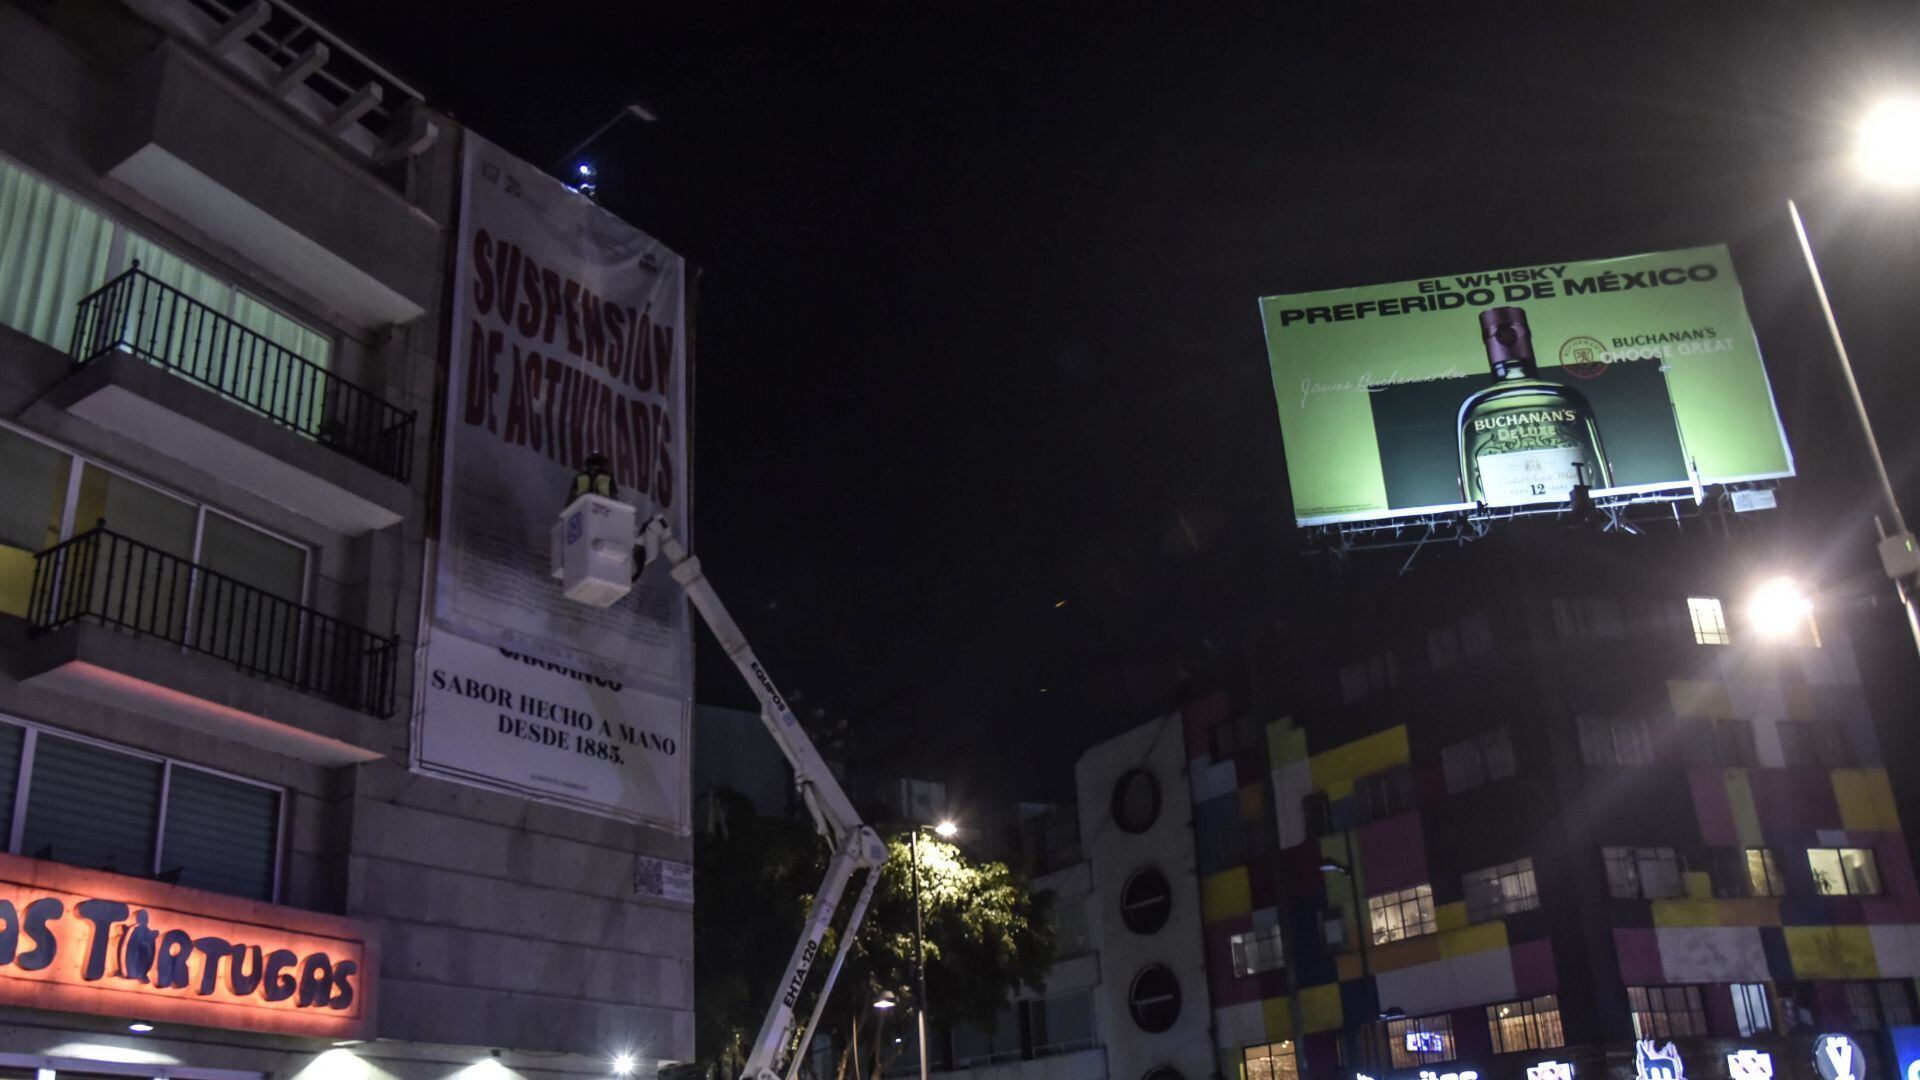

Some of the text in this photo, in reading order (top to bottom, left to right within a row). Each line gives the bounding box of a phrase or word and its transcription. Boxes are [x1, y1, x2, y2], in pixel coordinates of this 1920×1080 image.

[1280, 264, 1718, 327] PREFERIDO DE MÉXICO
[1418, 265, 1567, 294] EL WHISKY
[473, 228, 674, 396] SUSPENSIÓN
[1600, 344, 1673, 364] CHOOSE
[1678, 337, 1735, 356] GREAT
[1612, 327, 1717, 349] BUCHANAN'S
[1474, 410, 1576, 431] BUCHANAN'S
[1530, 483, 1546, 496] 12
[751, 662, 785, 711] EQUIPOS
[431, 669, 677, 756] SABOR HECHO A MANO
[498, 715, 570, 749] DESDE
[783, 940, 818, 1008] EHTA-120
